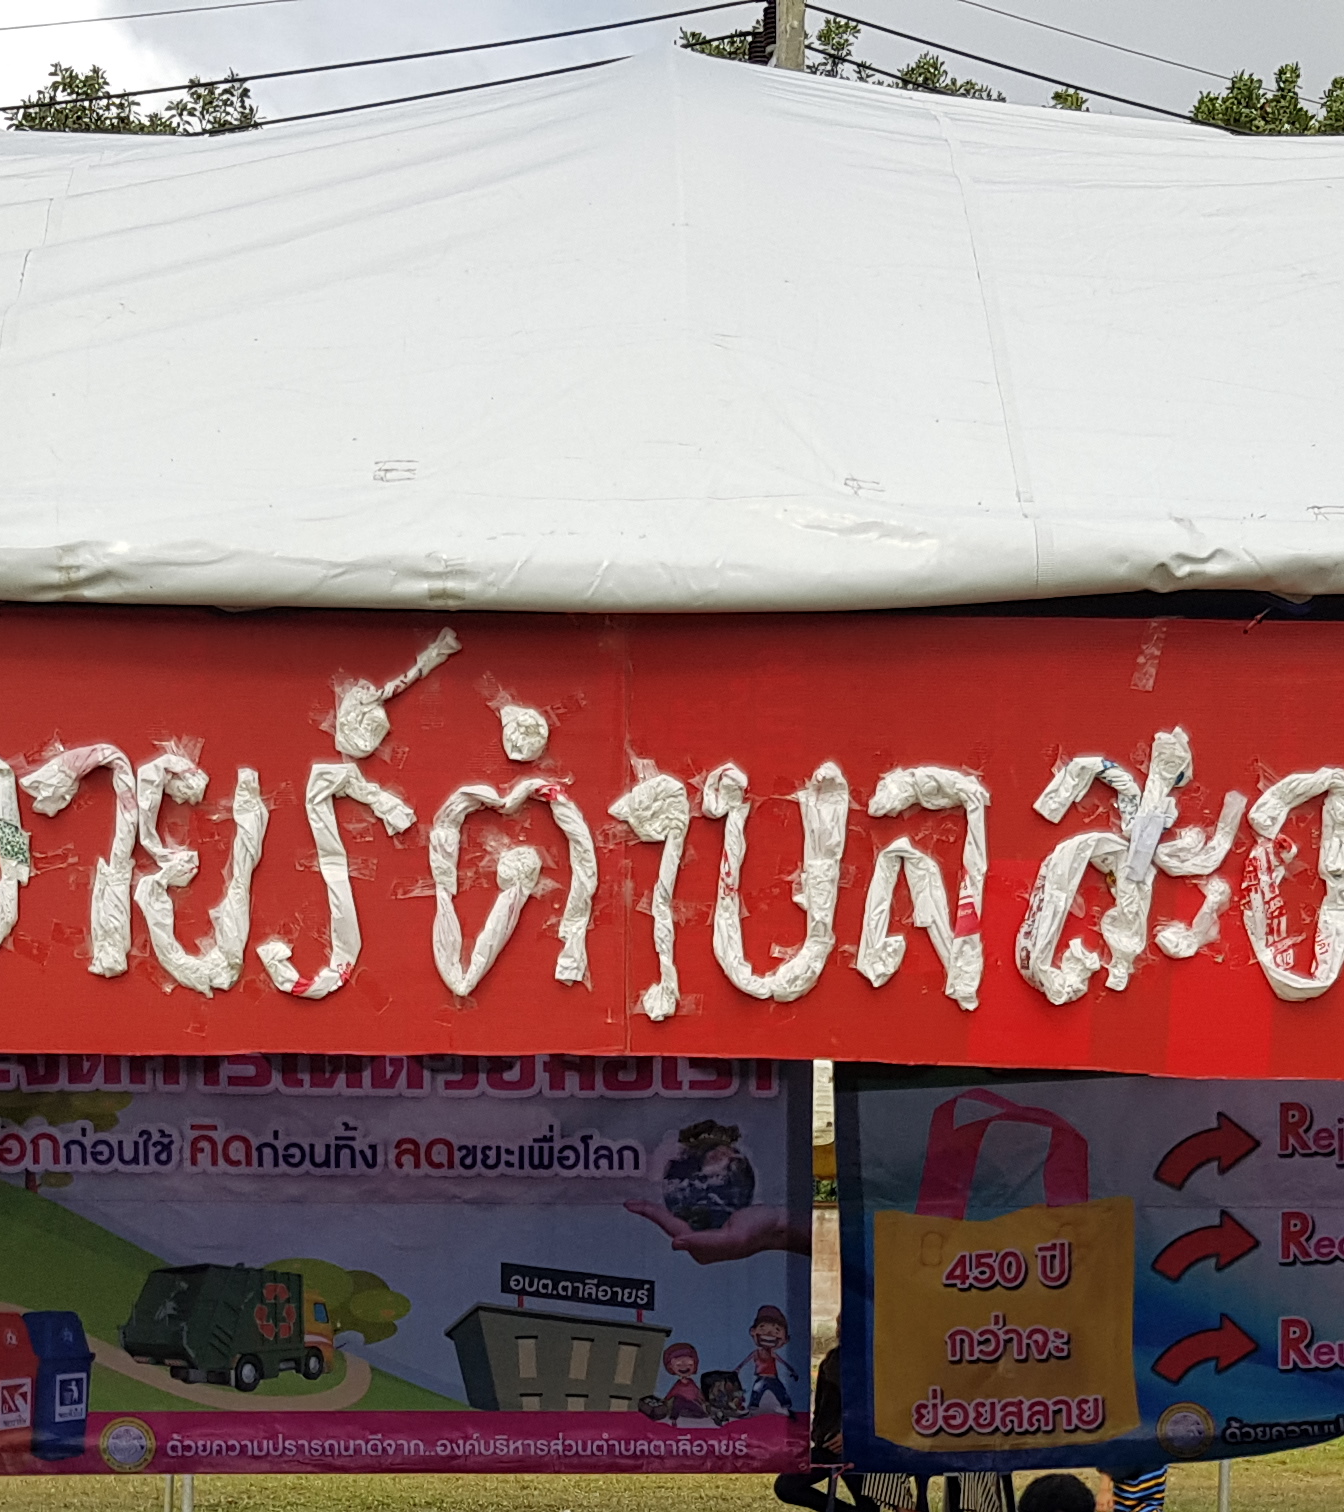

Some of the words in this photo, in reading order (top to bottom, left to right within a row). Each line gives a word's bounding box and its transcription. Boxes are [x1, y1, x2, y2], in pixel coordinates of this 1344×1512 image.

[188, 1119, 378, 1173] คิดก่อนทิ้ง
[393, 1124, 642, 1176] ลดขยะเพื่อโลก
[509, 1271, 651, 1306] อบต.ตาลีอายร์
[943, 1249, 1026, 1290] 450
[1035, 1240, 1070, 1288] ปี
[944, 1313, 1070, 1364] กว่าจะ
[912, 1392, 1104, 1436] ย่อยสลาย
